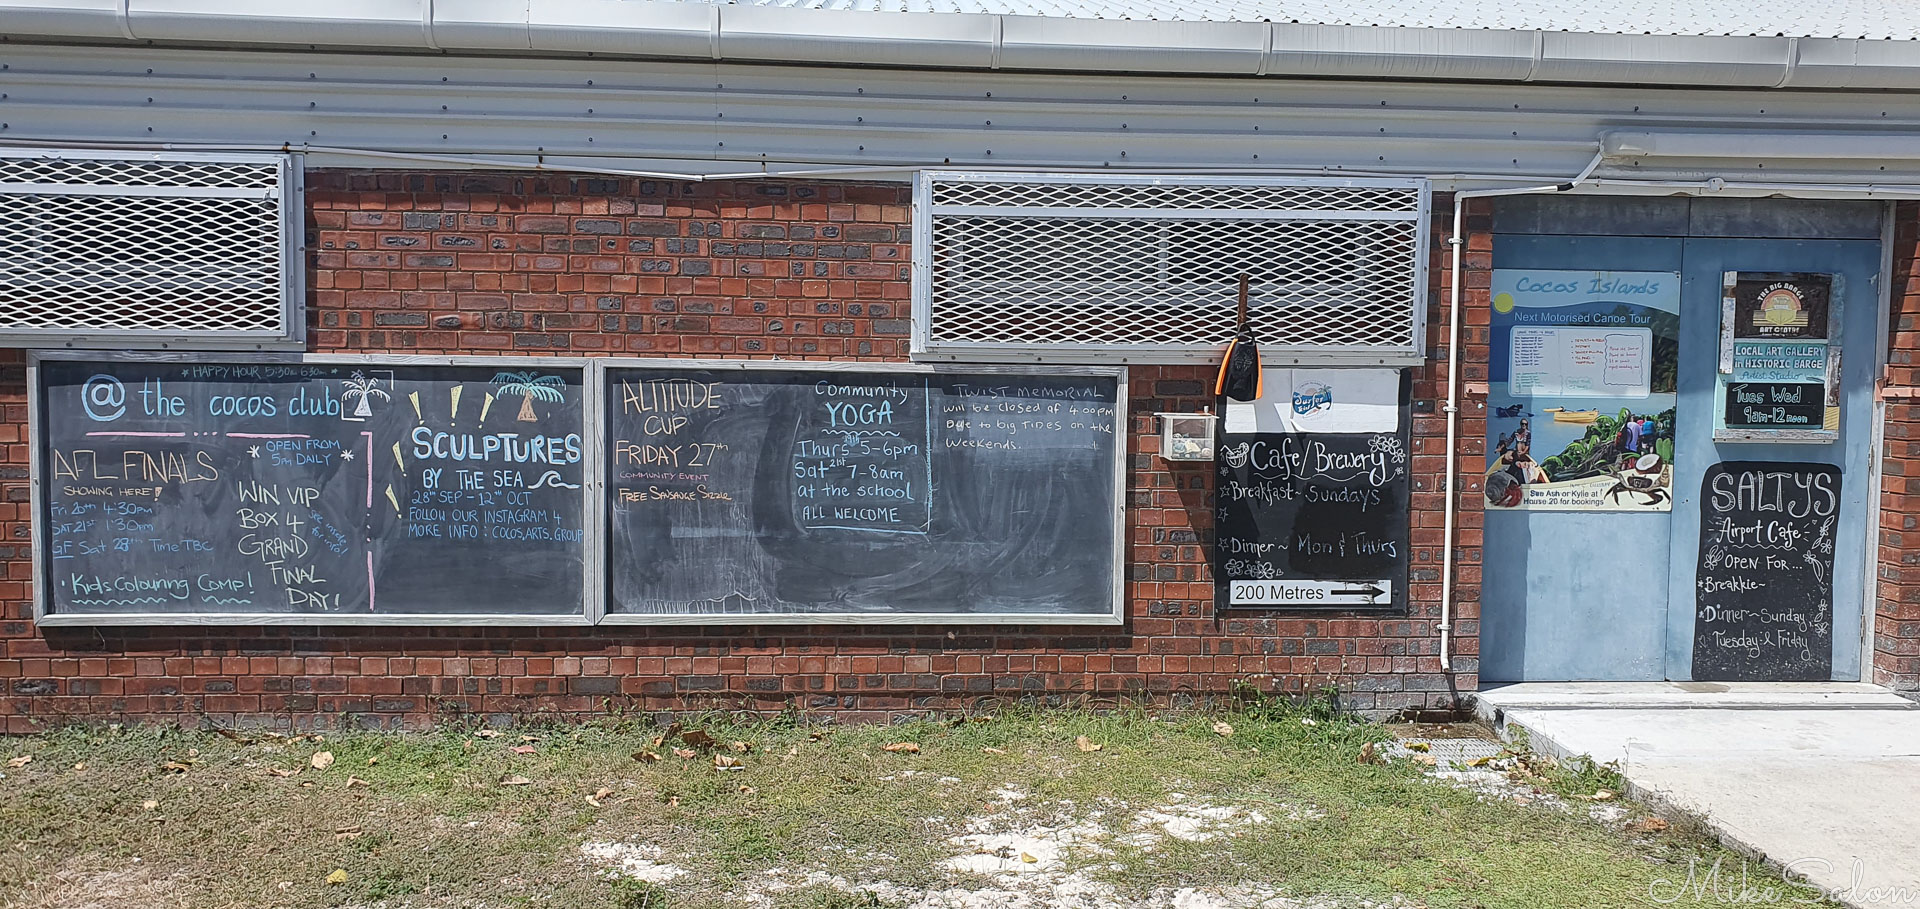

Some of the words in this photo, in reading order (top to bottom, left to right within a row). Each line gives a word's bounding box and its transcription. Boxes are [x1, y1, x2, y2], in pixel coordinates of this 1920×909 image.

[1516, 277, 1579, 293] Cocos
[1586, 278, 1660, 295] Islands
[1757, 288, 1770, 301] THE
[1769, 282, 1783, 291] BIG
[1514, 312, 1538, 322] Next
[1541, 312, 1590, 323] Motorised
[1593, 313, 1626, 324] Canoe
[1629, 313, 1650, 324] Tour
[1735, 346, 1763, 356] LOCAL
[1766, 346, 1782, 356] ART
[1785, 346, 1824, 357] GALLERY
[193, 366, 228, 378] HAPPY
[232, 366, 262, 379] HOUR
[1734, 360, 1743, 368] in
[1745, 359, 1791, 369] HISTORIC
[1794, 360, 1823, 369] BARGE
[1740, 370, 1766, 380] Artist
[1768, 370, 1802, 380] Studio
[81, 373, 126, 421] @
[138, 376, 186, 416] the
[209, 395, 277, 417] cocos
[288, 385, 340, 416] club
[622, 378, 724, 415] ALTITUDE
[815, 380, 908, 406] Community
[952, 383, 1010, 400] TWIST
[1017, 385, 1105, 400] MEMORIAL
[1732, 384, 1765, 404] Tues
[1771, 386, 1802, 403] Wed
[824, 399, 894, 428] YOGA
[943, 404, 965, 413] will
[972, 403, 990, 413] be
[998, 402, 1041, 414] closed
[644, 415, 688, 436] CUP
[979, 420, 992, 430] to
[996, 419, 1017, 435] big
[1021, 420, 1062, 431] TIDES
[1090, 422, 1113, 434] the
[266, 440, 301, 452] OPEN
[306, 438, 340, 450] FROM
[411, 426, 581, 465] SCULPTURES
[615, 440, 683, 468] FRIDAY
[797, 440, 850, 458] Thurs
[54, 449, 119, 480] AFL
[123, 450, 219, 484] FINALS
[296, 453, 332, 466] DAILY
[422, 467, 442, 489] BY
[455, 469, 485, 490] THE
[493, 470, 524, 488] SEA
[619, 471, 677, 480] COMMUNITY
[679, 472, 710, 482] EVENT
[794, 460, 830, 479] Sat
[63, 486, 113, 497] SHOWING
[238, 480, 280, 506] WIN
[286, 486, 320, 508] VIP
[438, 491, 463, 504] SEP
[506, 491, 533, 506] OCT
[618, 488, 648, 504] FREE
[797, 485, 815, 499] at
[821, 483, 850, 497] the
[857, 481, 915, 501] school
[1305, 485, 1381, 513] Sundays
[1571, 490, 1589, 499] Kylie
[1711, 470, 1836, 518] SALTYS
[51, 502, 67, 516] Fri
[1571, 498, 1604, 507] bookings
[236, 508, 279, 529] BOX
[286, 512, 304, 534] 4
[408, 506, 446, 522] FOLLOW
[451, 508, 479, 523] OUR
[484, 508, 548, 524] INSTAGRAM
[553, 509, 562, 525] 4
[802, 505, 825, 521] ALL
[834, 507, 902, 523] WELCOME
[408, 524, 442, 539] MORE
[1716, 516, 1763, 544] Airport
[1767, 520, 1802, 548] Cafe
[148, 538, 179, 552] Time
[180, 539, 214, 552] TBC
[238, 534, 308, 561] GRAND
[1230, 536, 1275, 558] Dinner
[1298, 532, 1332, 556] Mon
[1351, 531, 1397, 558] Thurs
[1724, 554, 1759, 570] OPEN
[265, 560, 327, 585] FINAL
[71, 573, 112, 595] Kids
[114, 575, 190, 599] Colouring
[1235, 585, 1265, 600] 200
[1270, 585, 1324, 600] Metres
[1712, 630, 1760, 658] Tuesday
[1777, 629, 1810, 661] Friday
